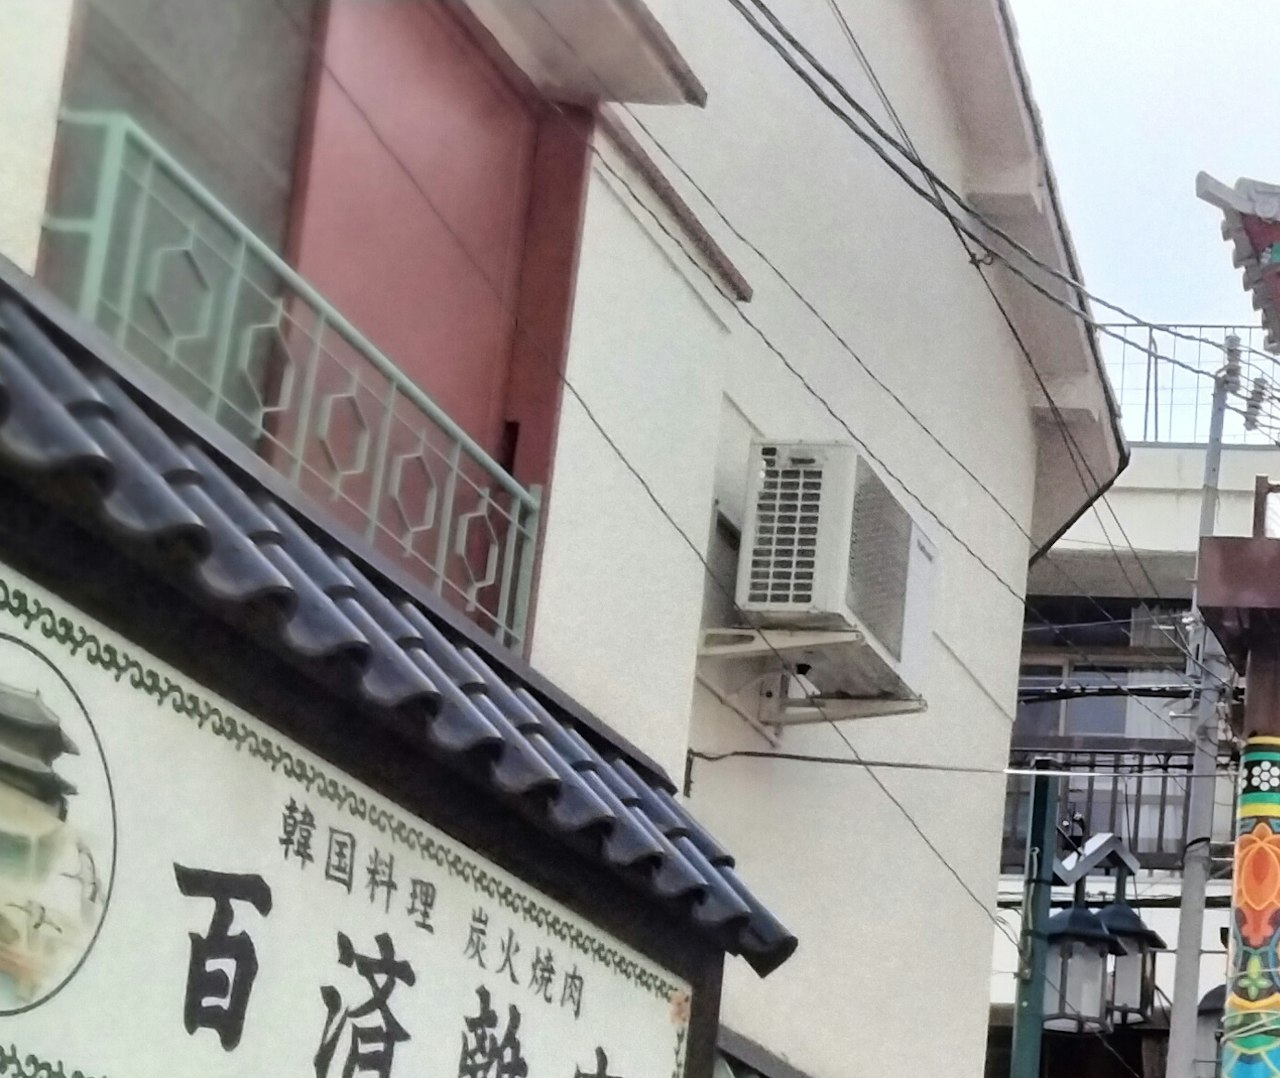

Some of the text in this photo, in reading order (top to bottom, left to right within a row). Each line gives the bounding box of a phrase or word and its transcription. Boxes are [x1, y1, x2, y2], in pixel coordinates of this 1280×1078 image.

[278, 796, 585, 1020] 韓国料理 炭火焼肉
